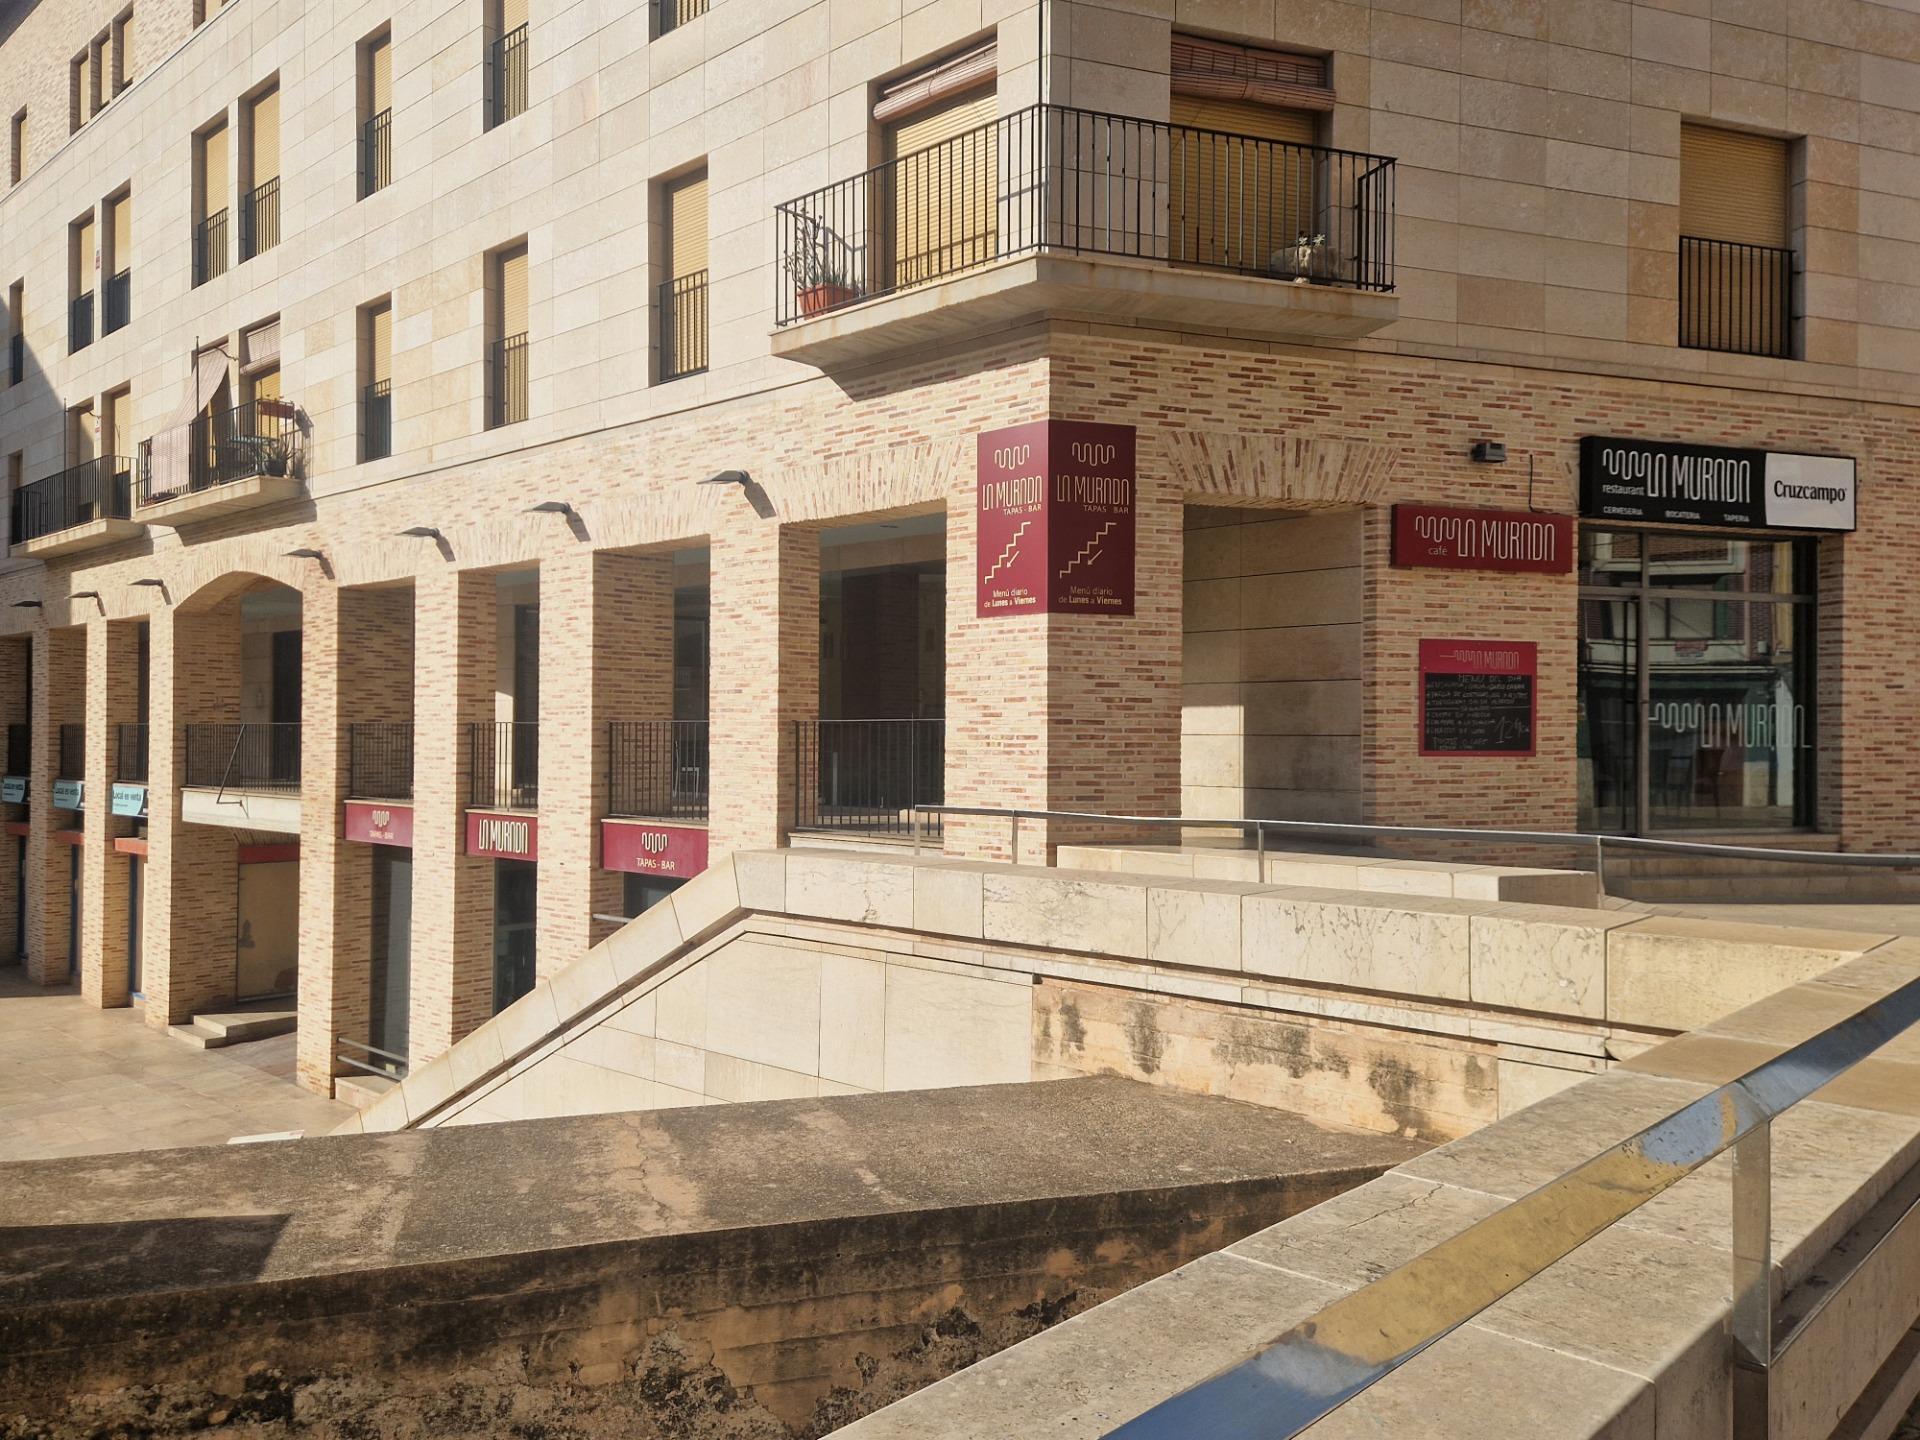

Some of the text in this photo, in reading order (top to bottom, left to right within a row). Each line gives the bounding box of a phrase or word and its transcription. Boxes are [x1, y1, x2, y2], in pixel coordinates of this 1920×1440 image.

[1672, 455, 1750, 503] MURADA
[996, 475, 1042, 508] MURADA
[1074, 475, 1129, 505] MURADA
[1602, 484, 1645, 495] restaurant
[1774, 480, 1846, 504] Cruzcampo
[1003, 507, 1023, 516] TAPAS
[1028, 503, 1042, 512] BAR
[1083, 504, 1129, 515] TAPAS BAR
[1481, 520, 1555, 561] MURADA
[1428, 545, 1448, 556] café
[992, 588, 1010, 598] Menú
[1092, 587, 1113, 596] diario
[992, 599, 1009, 607] Lunes
[1014, 596, 1037, 605] Viernes
[1069, 595, 1089, 604] Lunes
[1096, 596, 1122, 605] Viernes
[490, 820, 528, 854] MURADA
[636, 857, 657, 869] TAPAS
[661, 860, 675, 870] BAR
